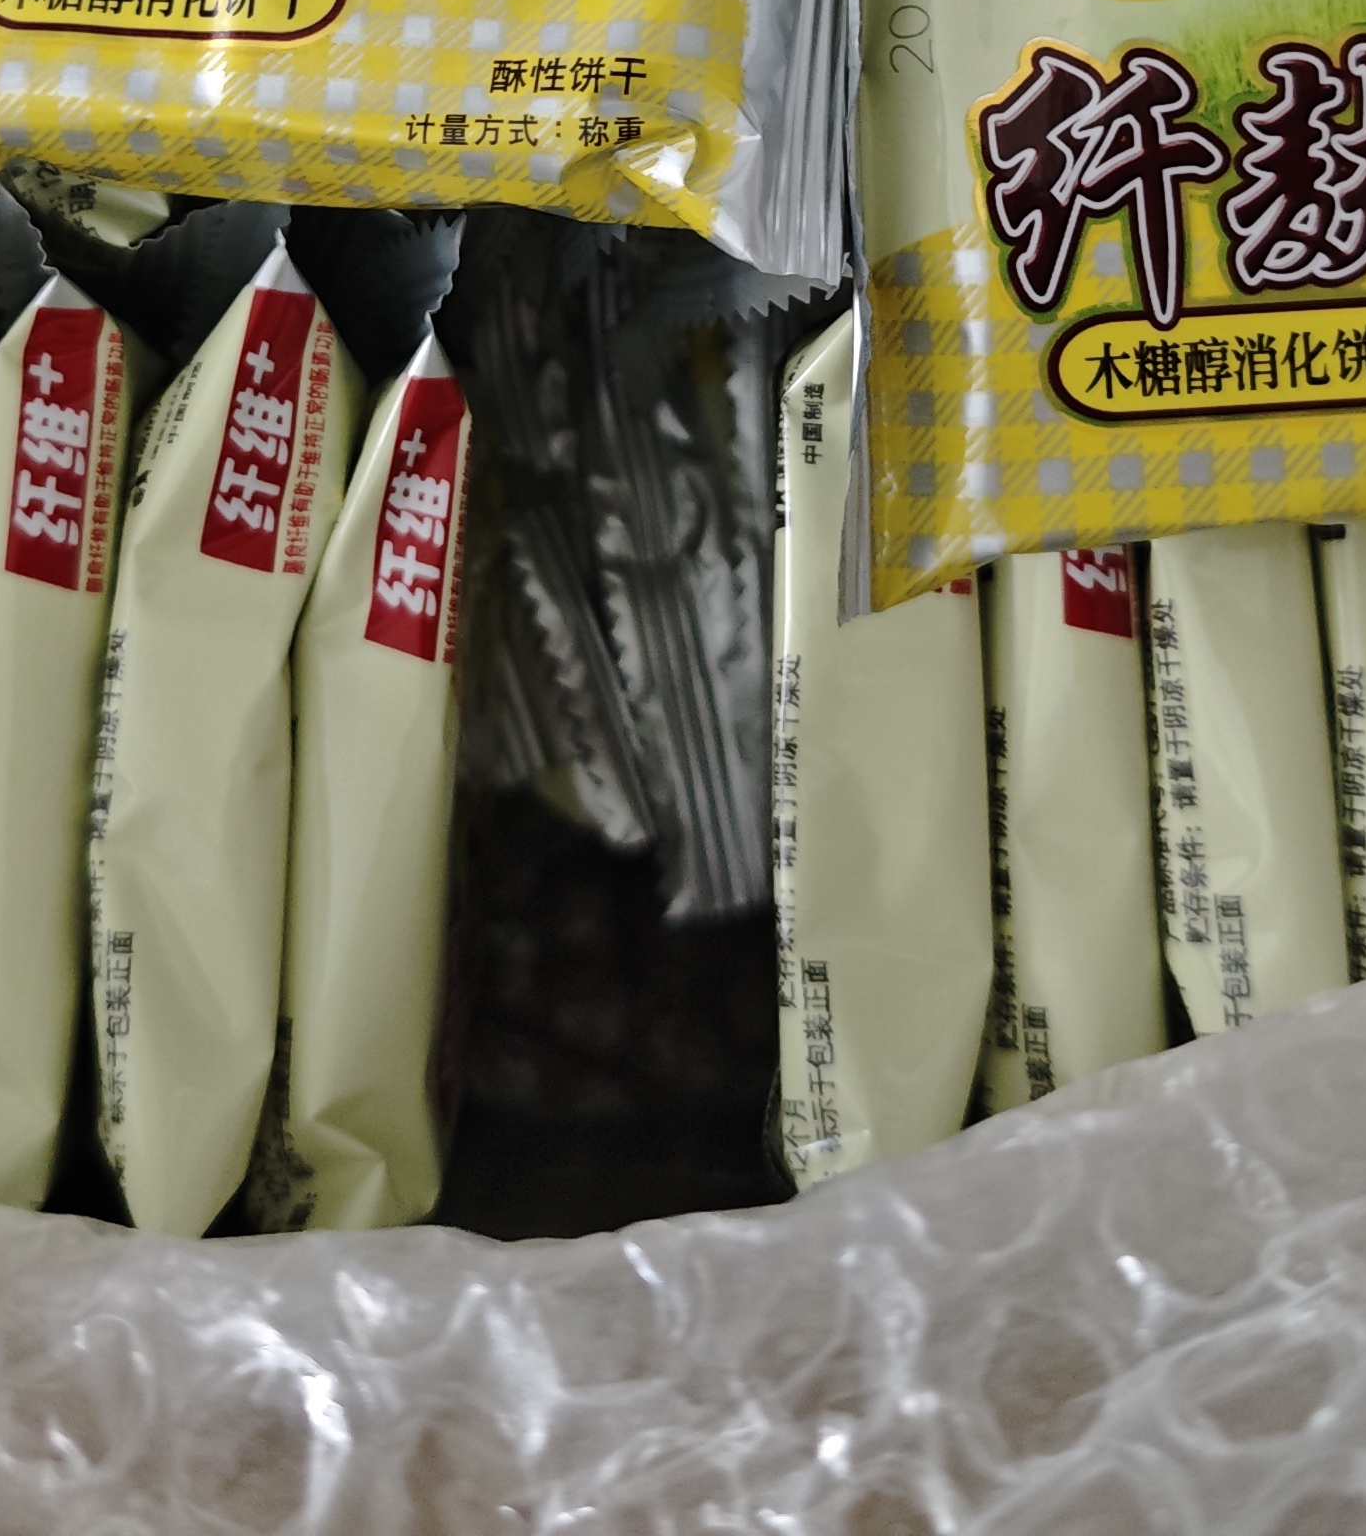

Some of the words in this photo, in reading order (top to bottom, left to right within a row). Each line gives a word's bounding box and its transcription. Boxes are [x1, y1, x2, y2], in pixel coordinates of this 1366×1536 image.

[489, 57, 647, 95] 酥性饼干
[800, 381, 825, 465] 中国制造
